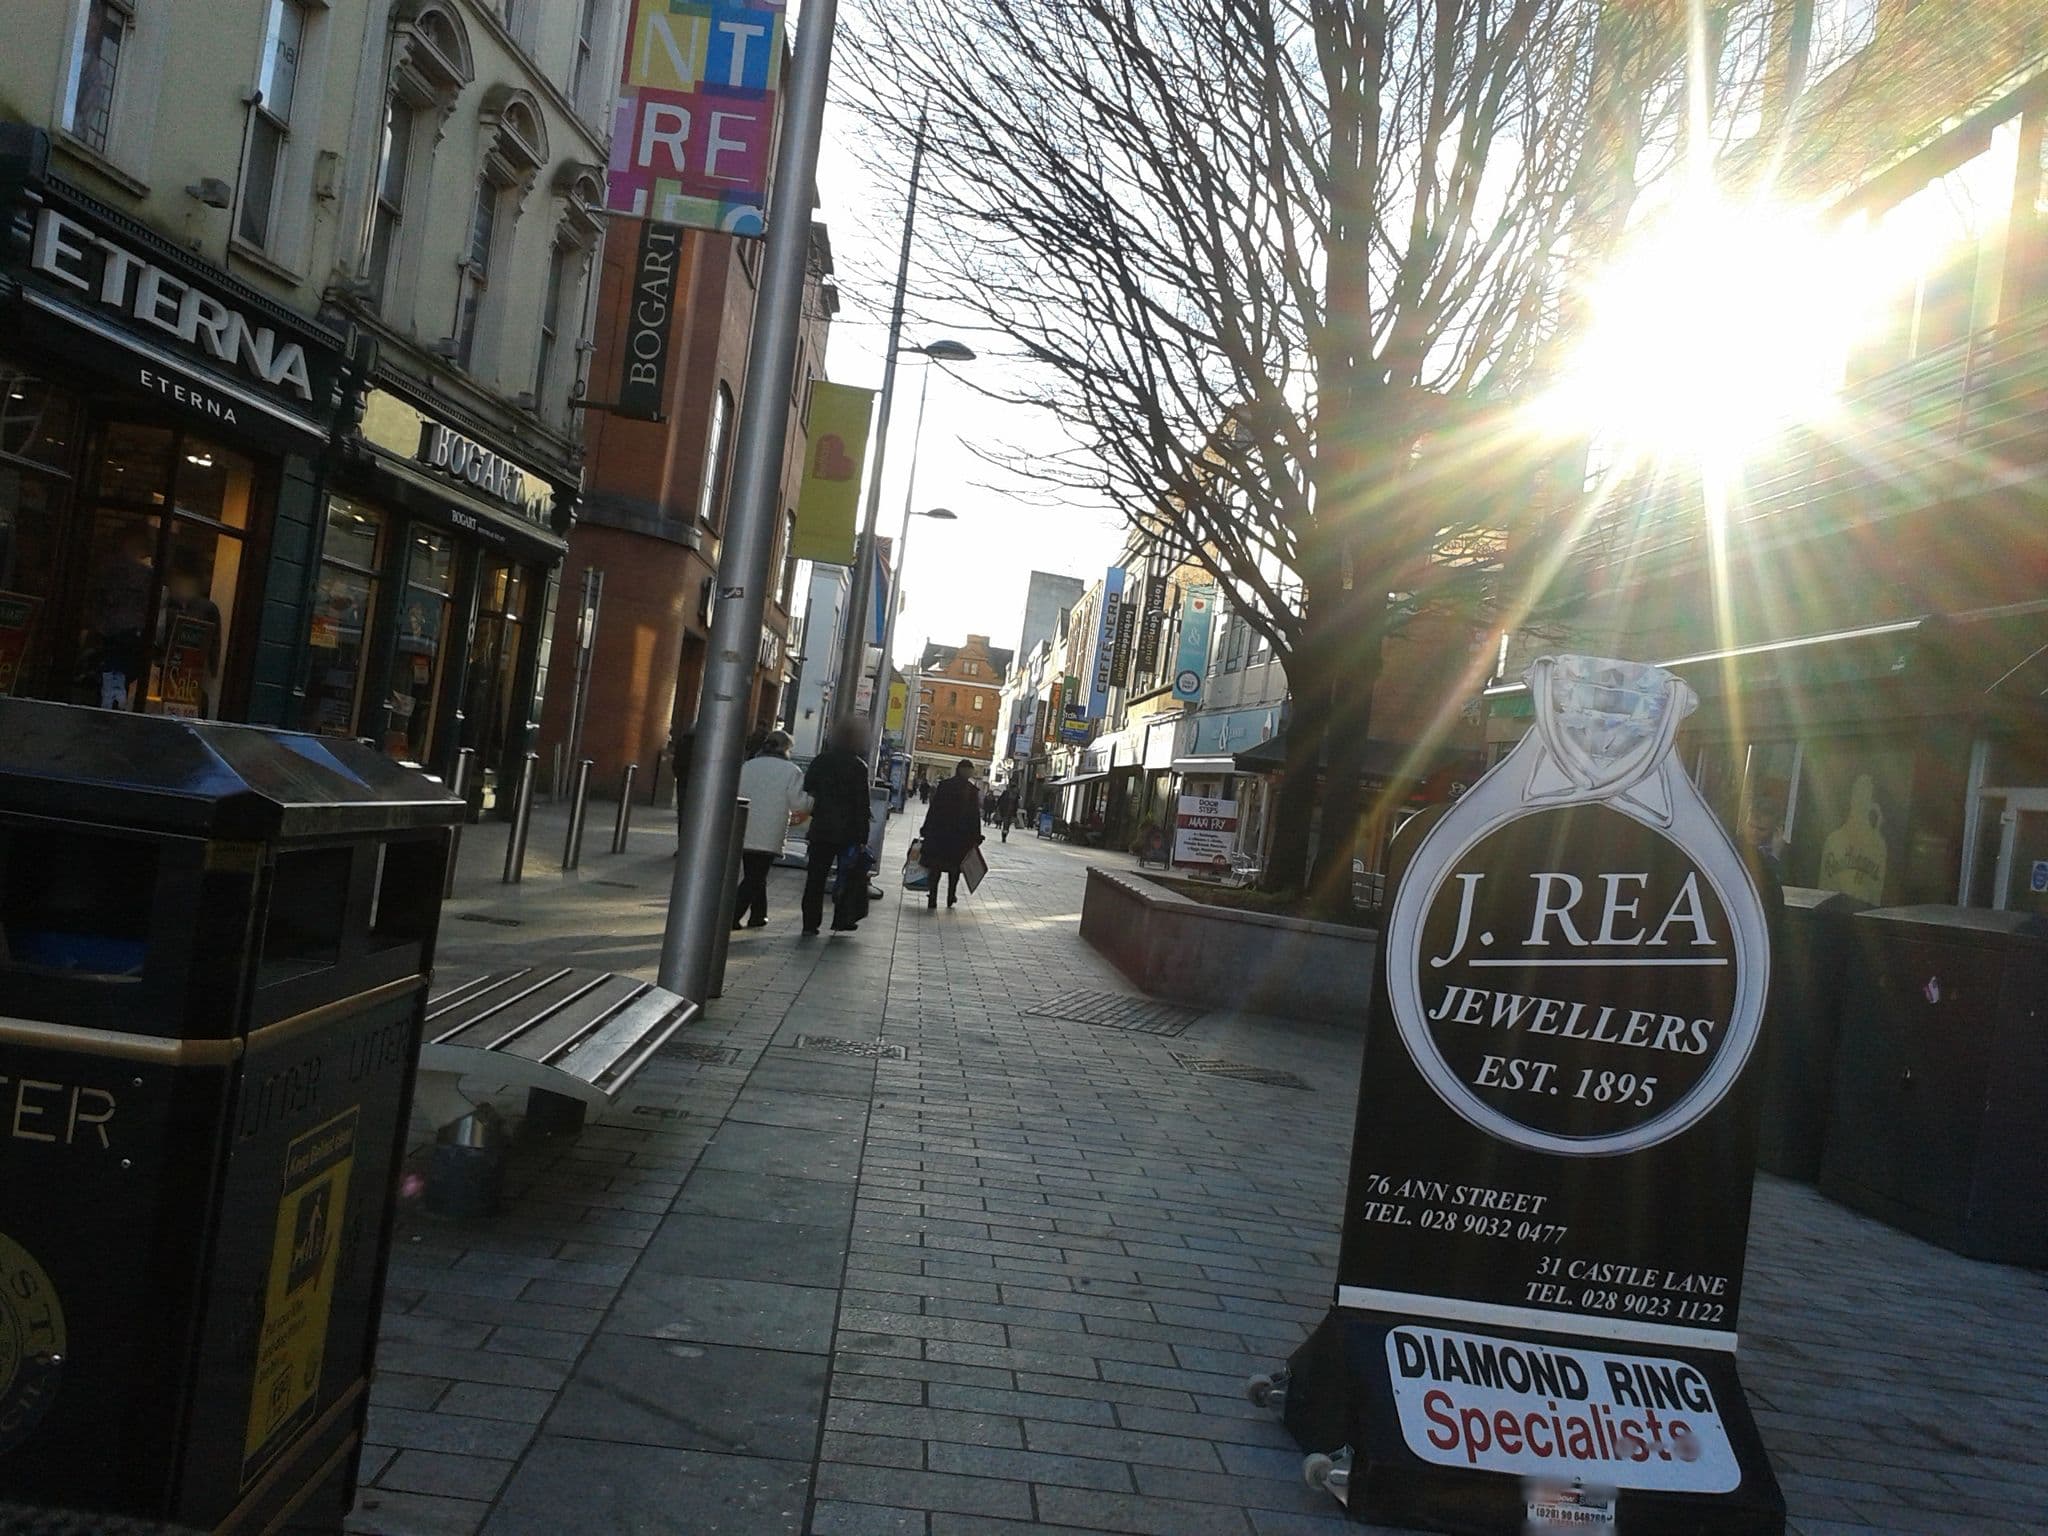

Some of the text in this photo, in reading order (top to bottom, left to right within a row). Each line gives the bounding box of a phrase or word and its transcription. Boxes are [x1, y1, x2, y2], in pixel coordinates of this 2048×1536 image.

[32, 207, 313, 401] ETERNA
[629, 224, 676, 387] BOGART
[139, 368, 238, 424] ETERNA
[431, 422, 525, 505] BOGART
[1103, 592, 1120, 641] NERO
[1430, 871, 1718, 968] J. REA
[1428, 984, 1715, 1055] JEWELLERS
[1473, 1054, 1657, 1108] EST. 1895
[1367, 1174, 1548, 1216] 76 ANN STREET
[1363, 1202, 1568, 1245] TEL. 028 9032 0477
[1525, 1281, 1725, 1324] TEL. 028 9023 1122
[1536, 1256, 1729, 1297] 31 CASTLE LANE
[1393, 1331, 1713, 1414] DIAMOND RING
